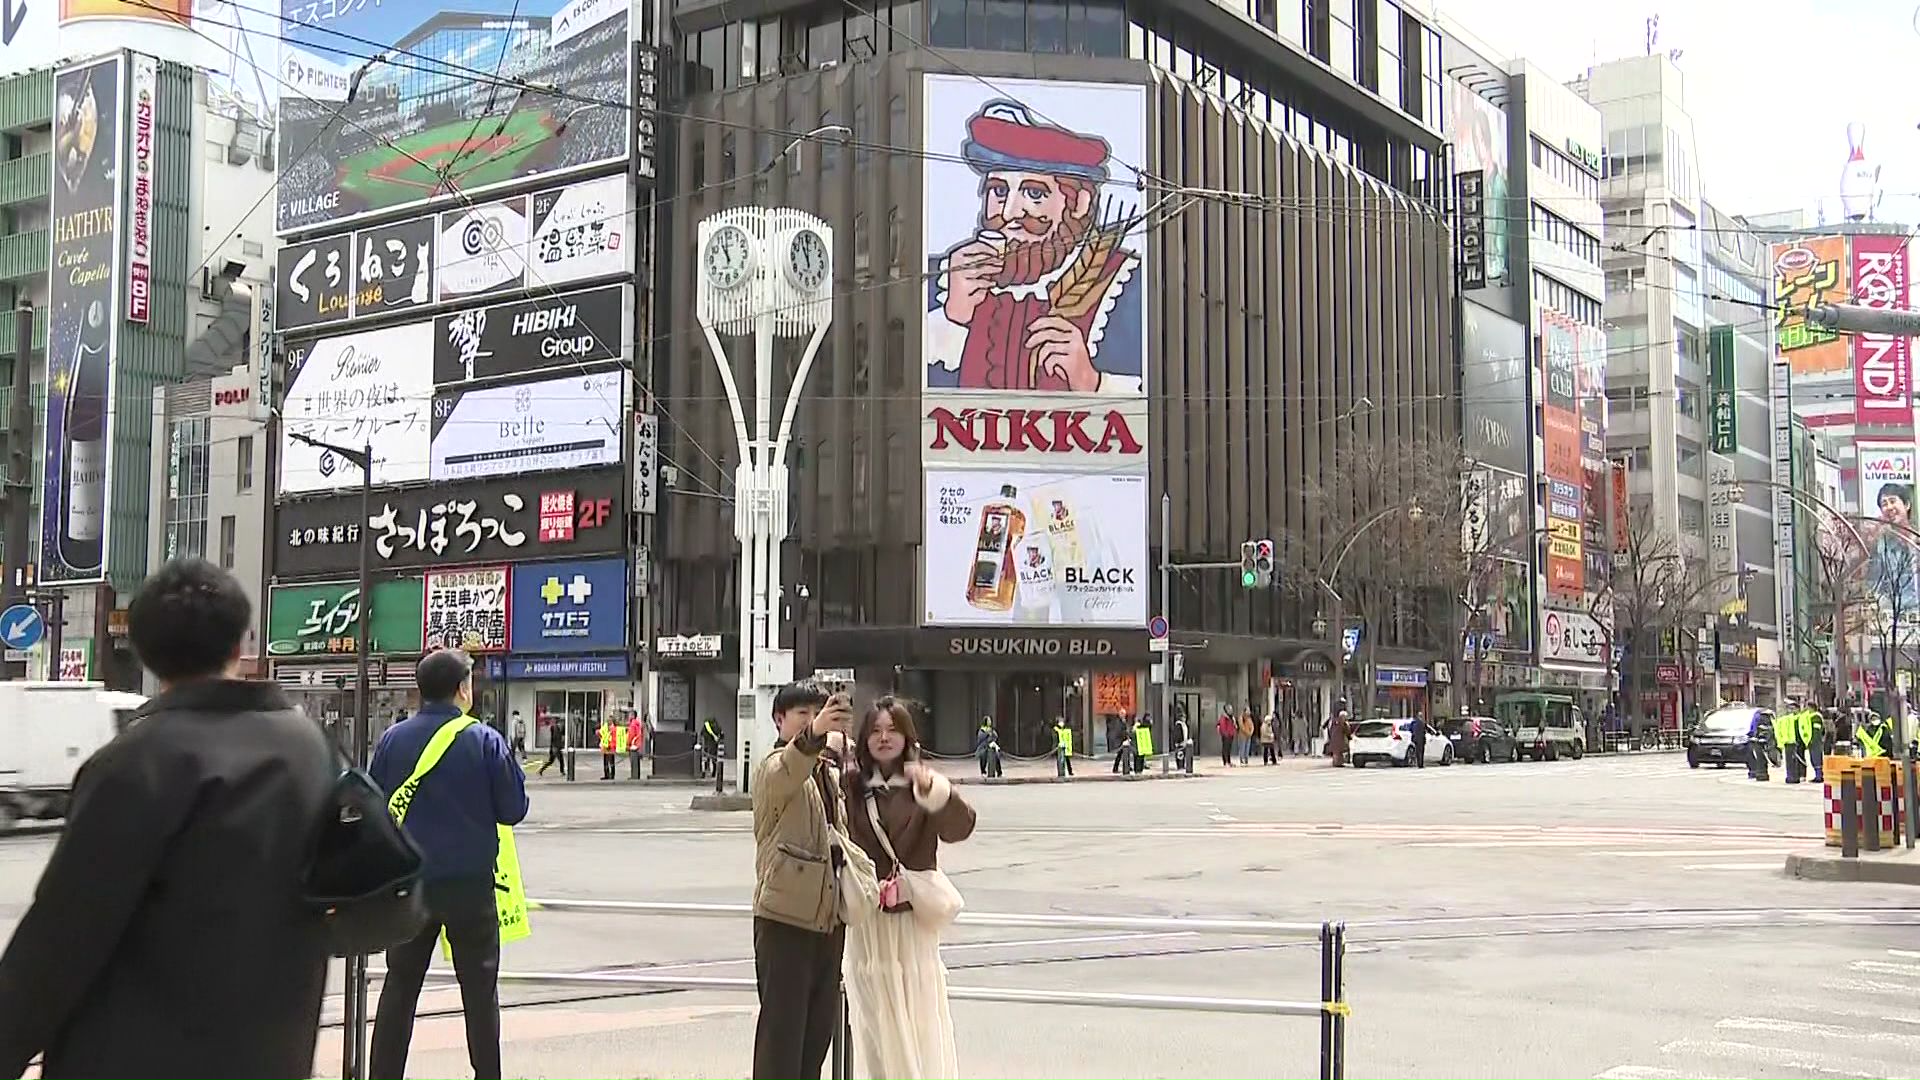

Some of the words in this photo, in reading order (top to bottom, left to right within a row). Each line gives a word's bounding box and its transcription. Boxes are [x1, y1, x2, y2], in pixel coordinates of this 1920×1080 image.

[291, 192, 340, 216] VILLAGE
[317, 285, 383, 314] Lounge
[512, 304, 578, 336] HIBIKI
[541, 335, 594, 359] Group
[500, 417, 546, 440] Belle
[927, 406, 1143, 454] NIKKA
[940, 487, 965, 496] クセの
[940, 497, 958, 506] ない
[541, 495, 574, 514] 炭火焼き
[578, 500, 613, 529] 2F
[940, 506, 972, 516] クリアな
[369, 494, 526, 558] さっぽろっこ
[940, 516, 967, 525] 味わい
[289, 524, 360, 547] 北の味紀行
[1065, 567, 1134, 584] BLACK
[950, 638, 1061, 655] SUSUKINO
[1069, 638, 1117, 655] BLD.
[534, 663, 560, 674] HOKKAIDO
[562, 663, 579, 673] HAPPY
